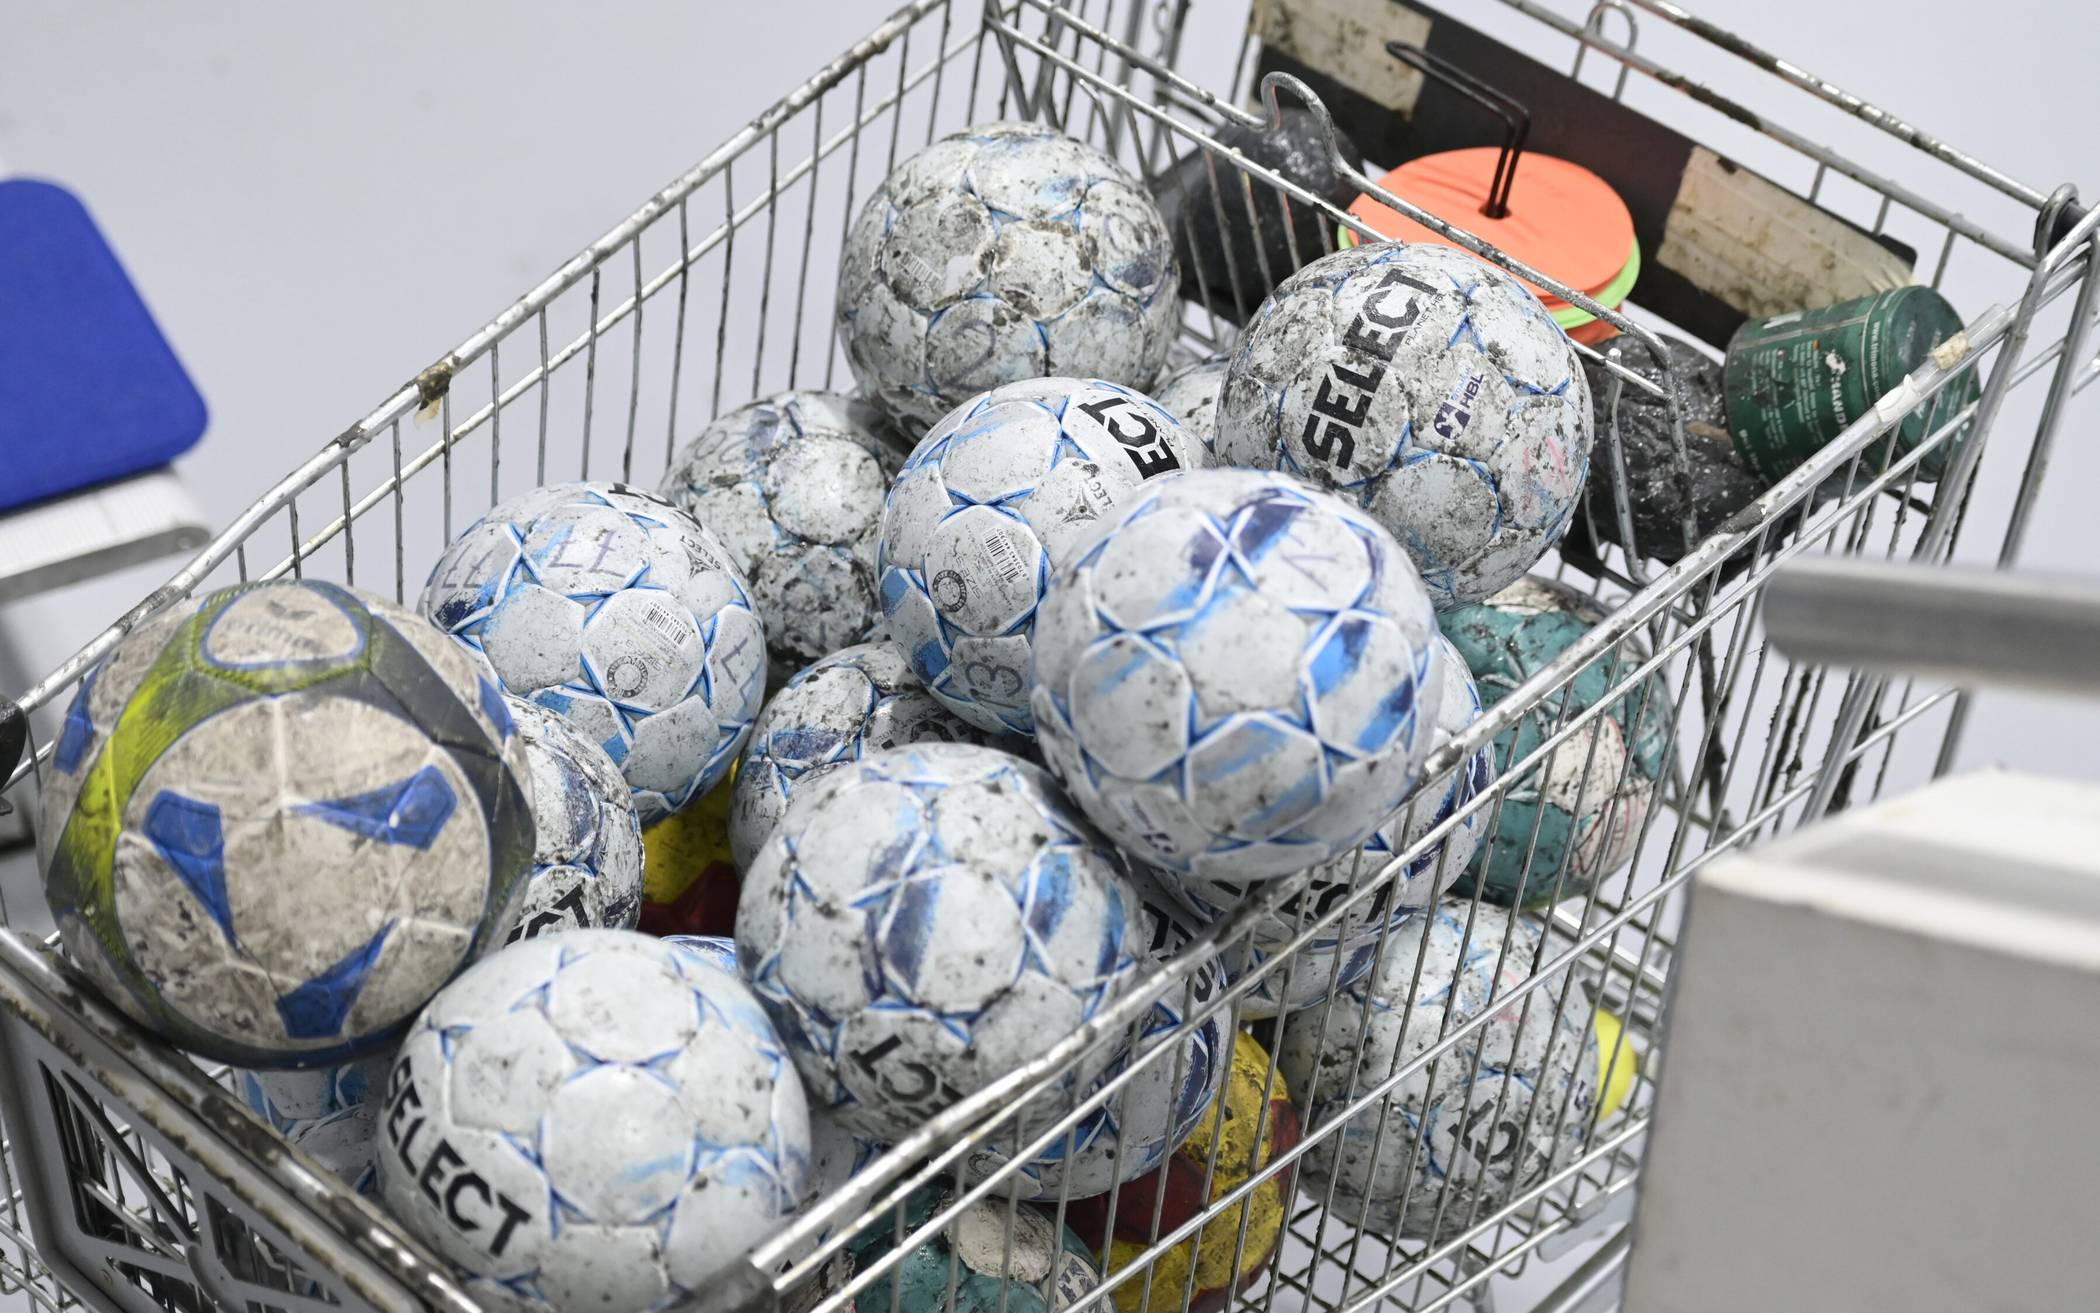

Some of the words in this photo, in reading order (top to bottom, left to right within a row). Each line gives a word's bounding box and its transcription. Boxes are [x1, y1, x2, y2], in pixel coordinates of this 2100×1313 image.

[1302, 268, 1439, 470] SELECT
[1460, 374, 1485, 411] HBL
[1078, 397, 1181, 480] ECT
[679, 534, 722, 571] SELECT
[386, 1056, 532, 1256] SELECT
